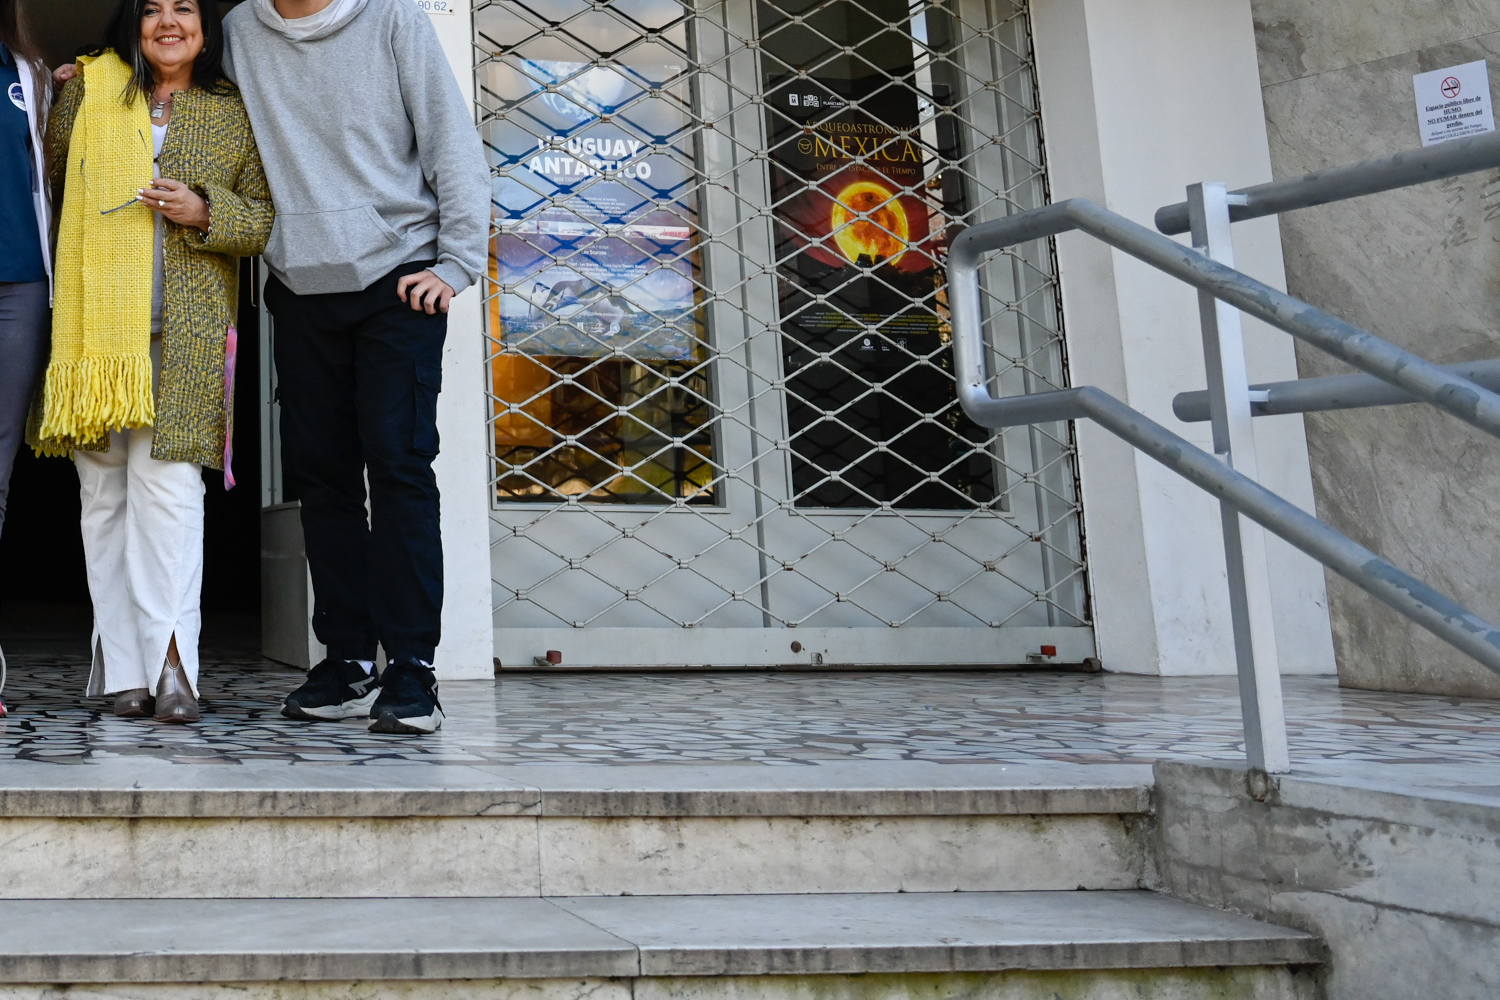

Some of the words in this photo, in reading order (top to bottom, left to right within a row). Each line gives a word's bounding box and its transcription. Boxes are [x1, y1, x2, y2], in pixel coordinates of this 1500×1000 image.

[434, 1, 446, 11] 62
[537, 134, 641, 158] URUGUAY
[813, 136, 920, 163] MEXICA
